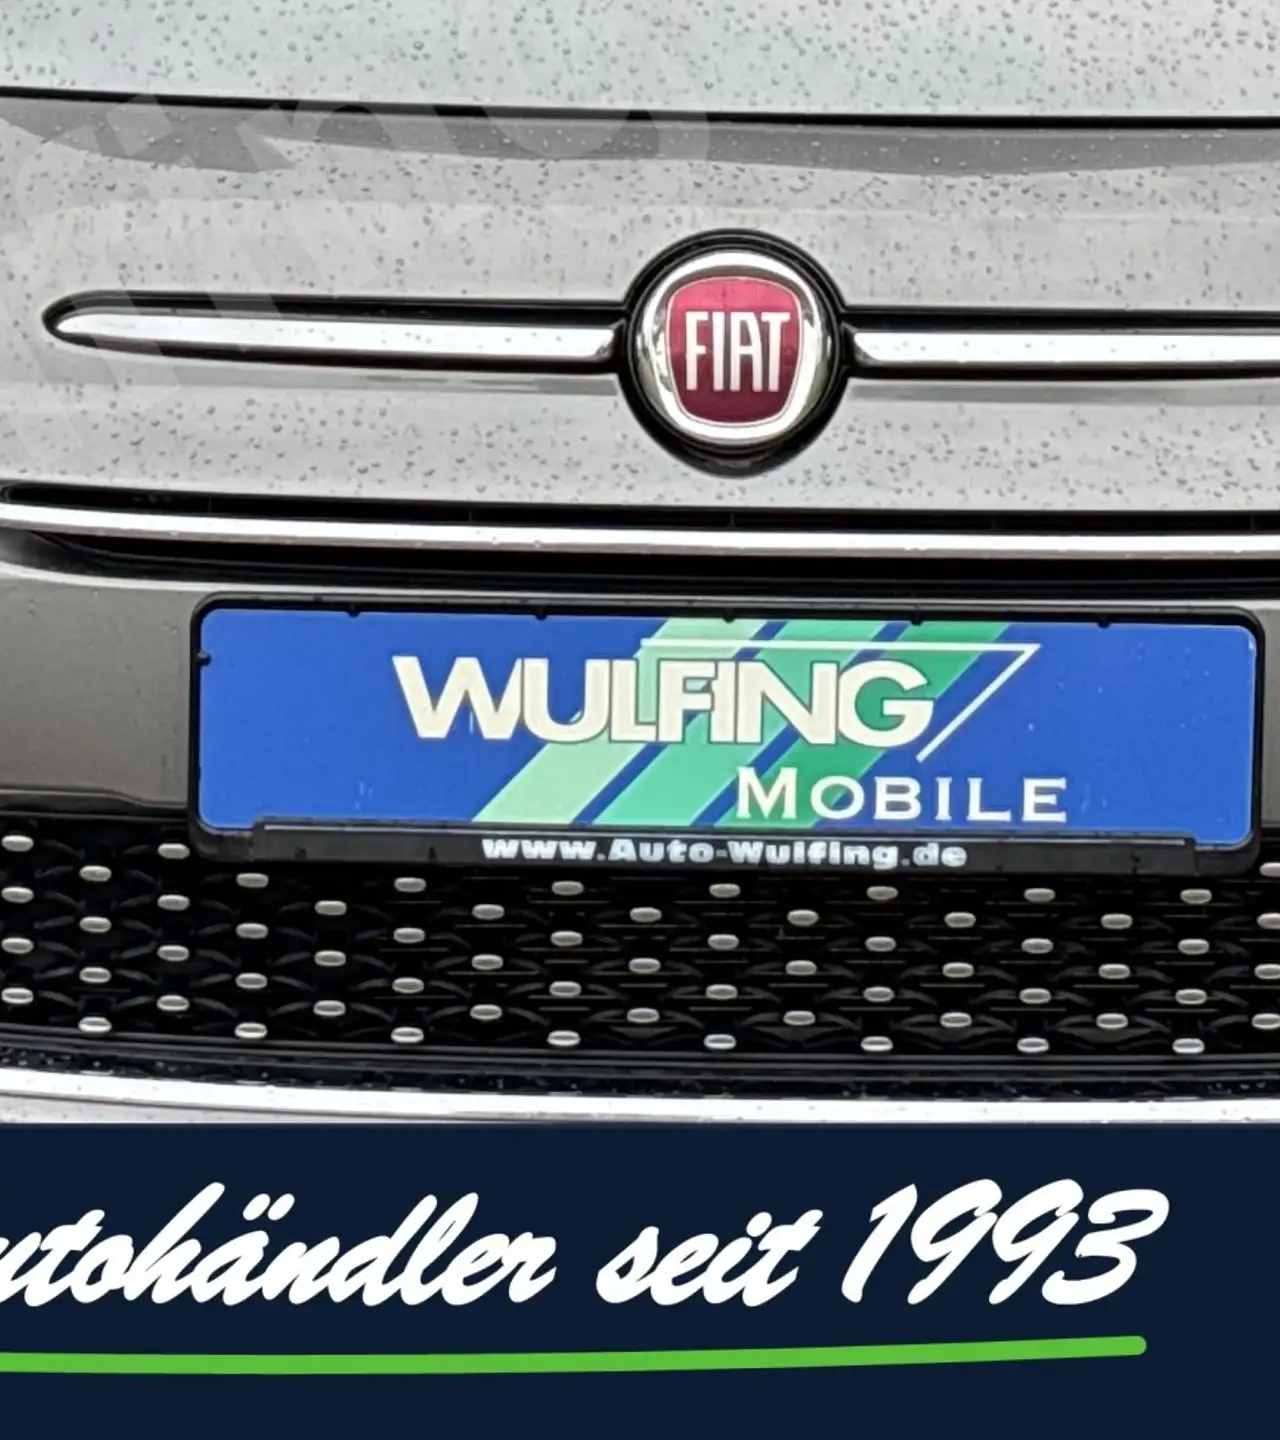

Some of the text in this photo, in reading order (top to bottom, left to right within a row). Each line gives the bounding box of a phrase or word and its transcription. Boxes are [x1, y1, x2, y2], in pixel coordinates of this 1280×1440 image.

[685, 311, 791, 392] FIAT
[392, 655, 934, 748] WULFING
[737, 766, 1068, 824] MOBILE
[481, 837, 968, 871] www.Auto-Wulfing.de
